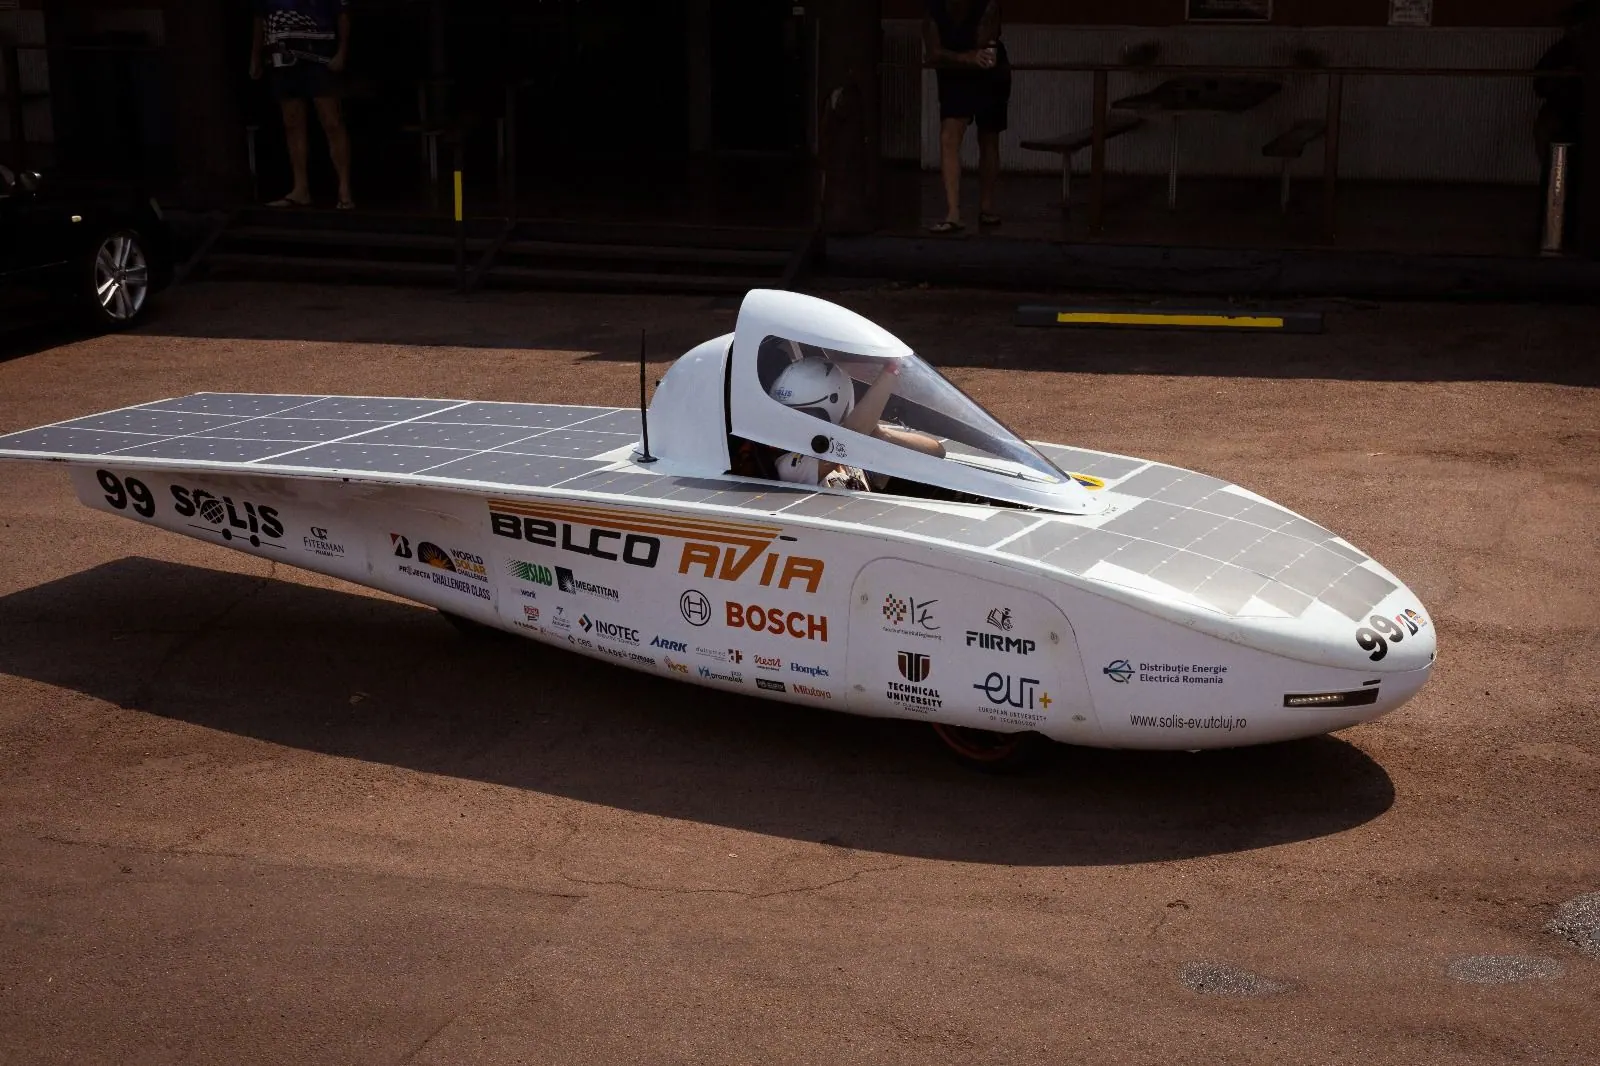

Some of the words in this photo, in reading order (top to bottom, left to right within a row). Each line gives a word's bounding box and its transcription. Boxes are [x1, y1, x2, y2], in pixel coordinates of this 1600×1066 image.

[97, 469, 155, 518] 99
[170, 484, 284, 539] SOLIS
[303, 536, 345, 553] FITERMAN
[449, 548, 484, 565] WORLD
[454, 559, 487, 575] SOLAR
[457, 568, 489, 583] CHALLENGE
[432, 572, 471, 594] CHALLENGER
[471, 585, 491, 601] CLASS
[574, 579, 620, 599] MEGATITAN
[725, 601, 828, 642] BOSCH
[595, 620, 640, 642] INOTEC
[1355, 614, 1404, 662] 99
[650, 634, 688, 653] ARRK
[965, 630, 1036, 656] FIIRMP
[1192, 664, 1228, 675] Energie
[1182, 675, 1224, 684] Romania
[888, 682, 940, 698] TECHNICAL
[886, 691, 943, 708] UNIVERSITY
[1130, 713, 1247, 731] www.solis-ev.utcluj.ro
